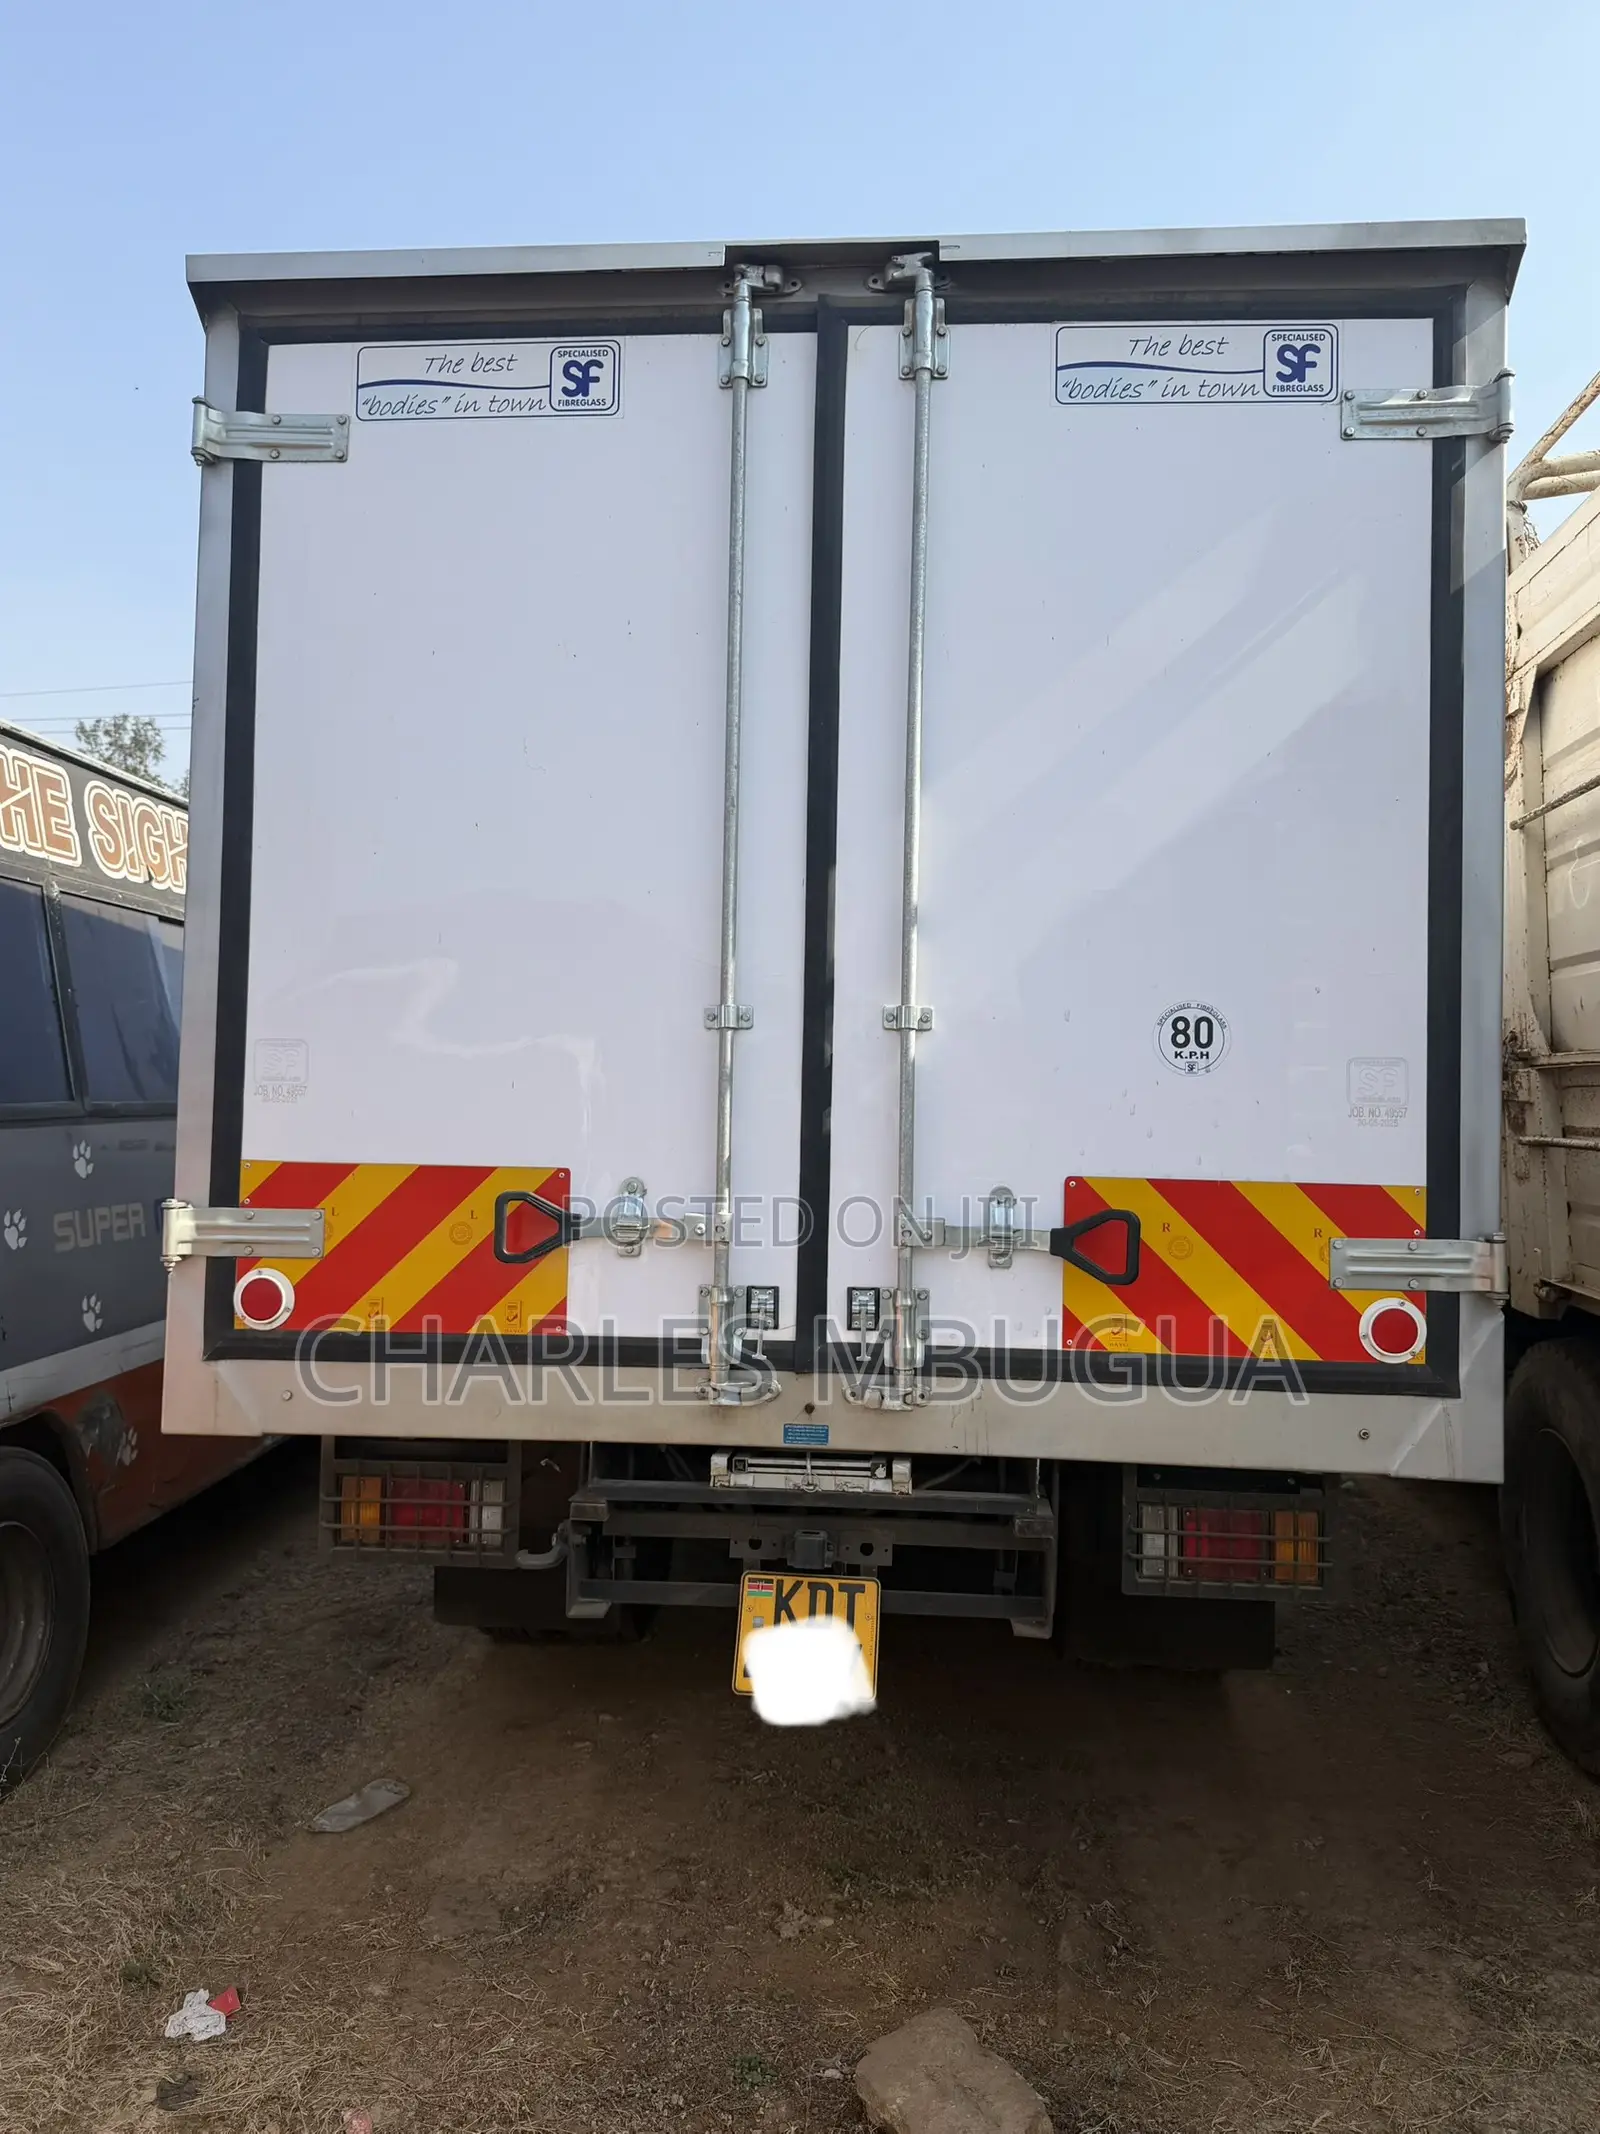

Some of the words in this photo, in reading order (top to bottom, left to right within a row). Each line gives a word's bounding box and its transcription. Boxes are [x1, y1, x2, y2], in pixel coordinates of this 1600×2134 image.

[1130, 336, 1169, 356] The
[1178, 334, 1230, 355] best
[1271, 333, 1326, 342] SPECIALISED
[425, 354, 463, 374] The
[471, 352, 518, 373] best
[557, 349, 609, 359] SPECIALISED
[1161, 375, 1191, 397] in
[1199, 379, 1260, 397] town
[1272, 384, 1324, 393] FIBREGLASS
[454, 392, 481, 413] in
[489, 395, 547, 412] town
[557, 398, 607, 407] FIBREGLASS
[1171, 1016, 1214, 1049] 80
[1174, 1051, 1210, 1060] K.P.H
[53, 1203, 146, 1252] SUPER
